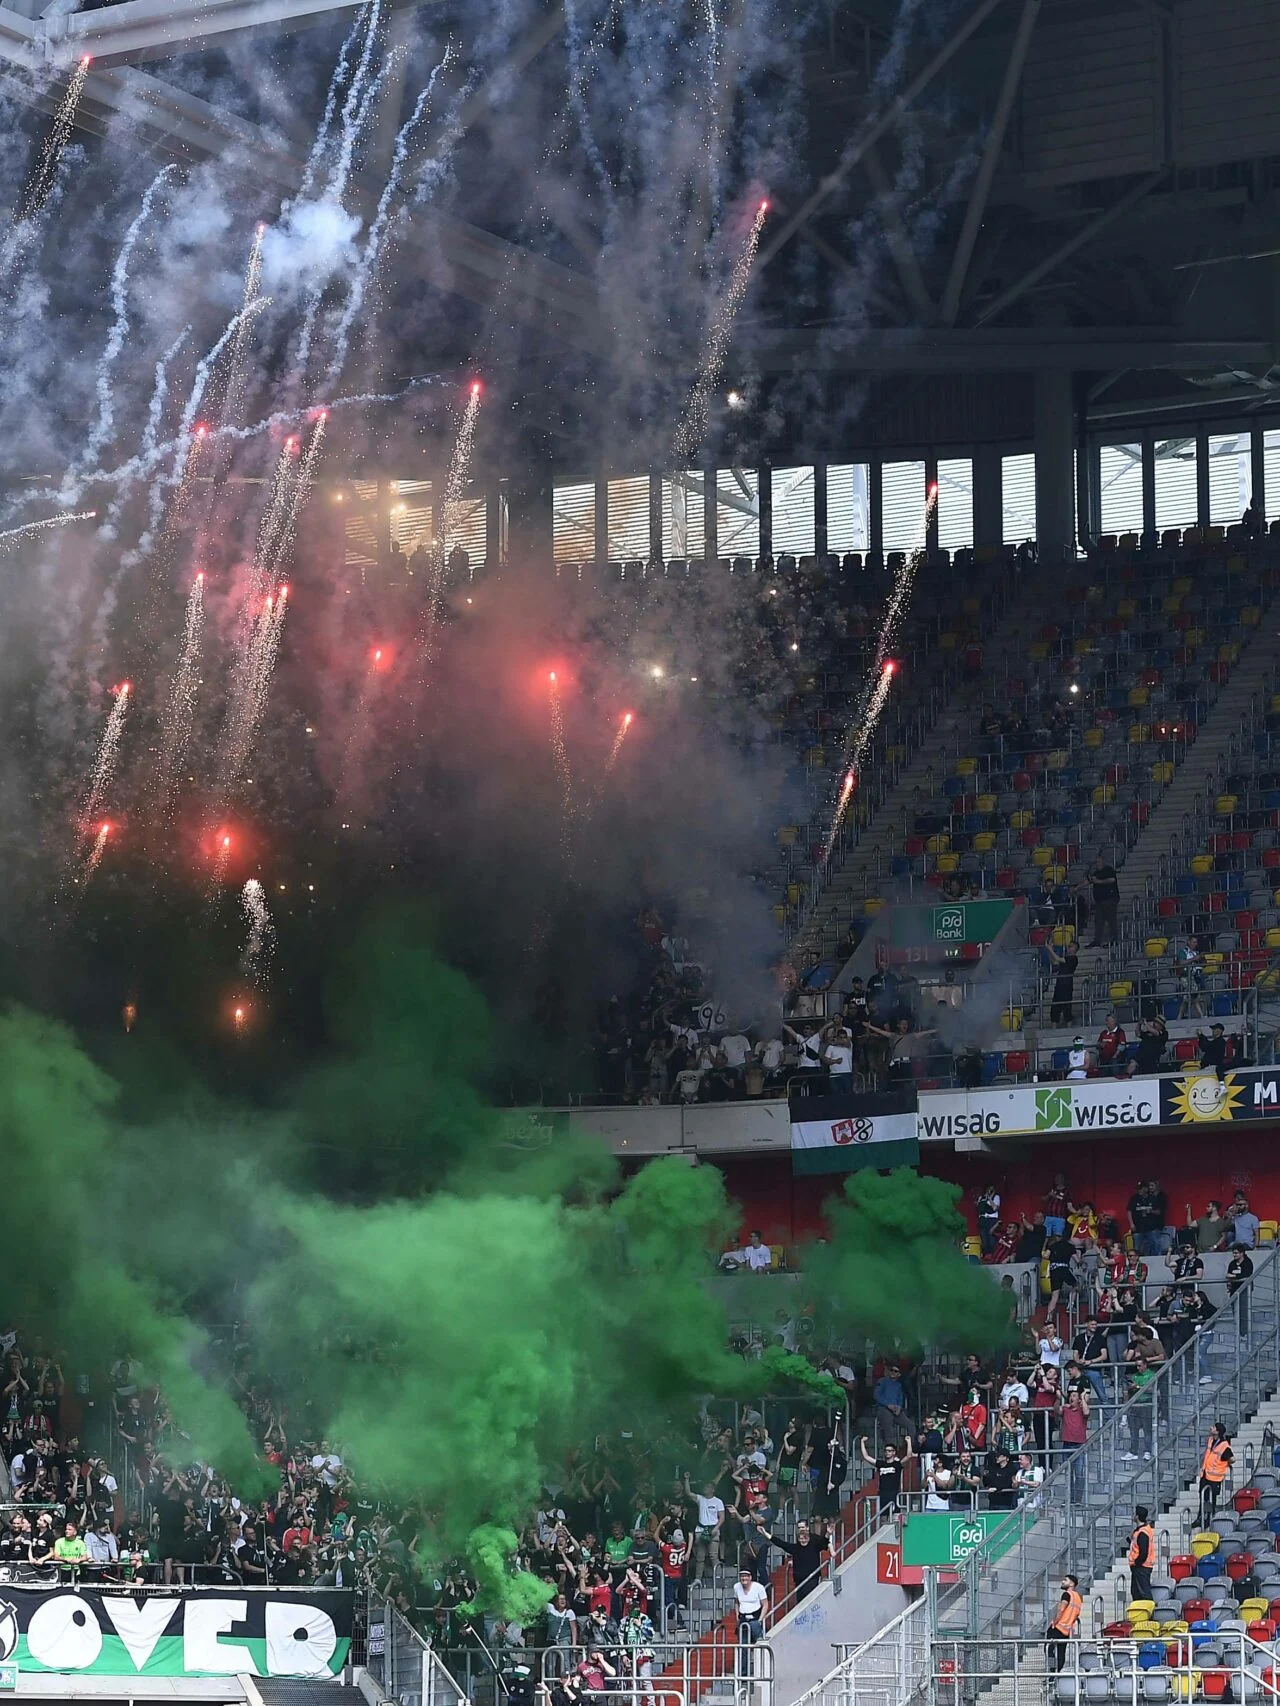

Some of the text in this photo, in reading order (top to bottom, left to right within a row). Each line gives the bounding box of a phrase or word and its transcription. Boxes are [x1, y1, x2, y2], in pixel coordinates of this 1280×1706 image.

[936, 929, 962, 939] Bank
[669, 1549, 686, 1566] 96
[885, 1551, 899, 1578] 21
